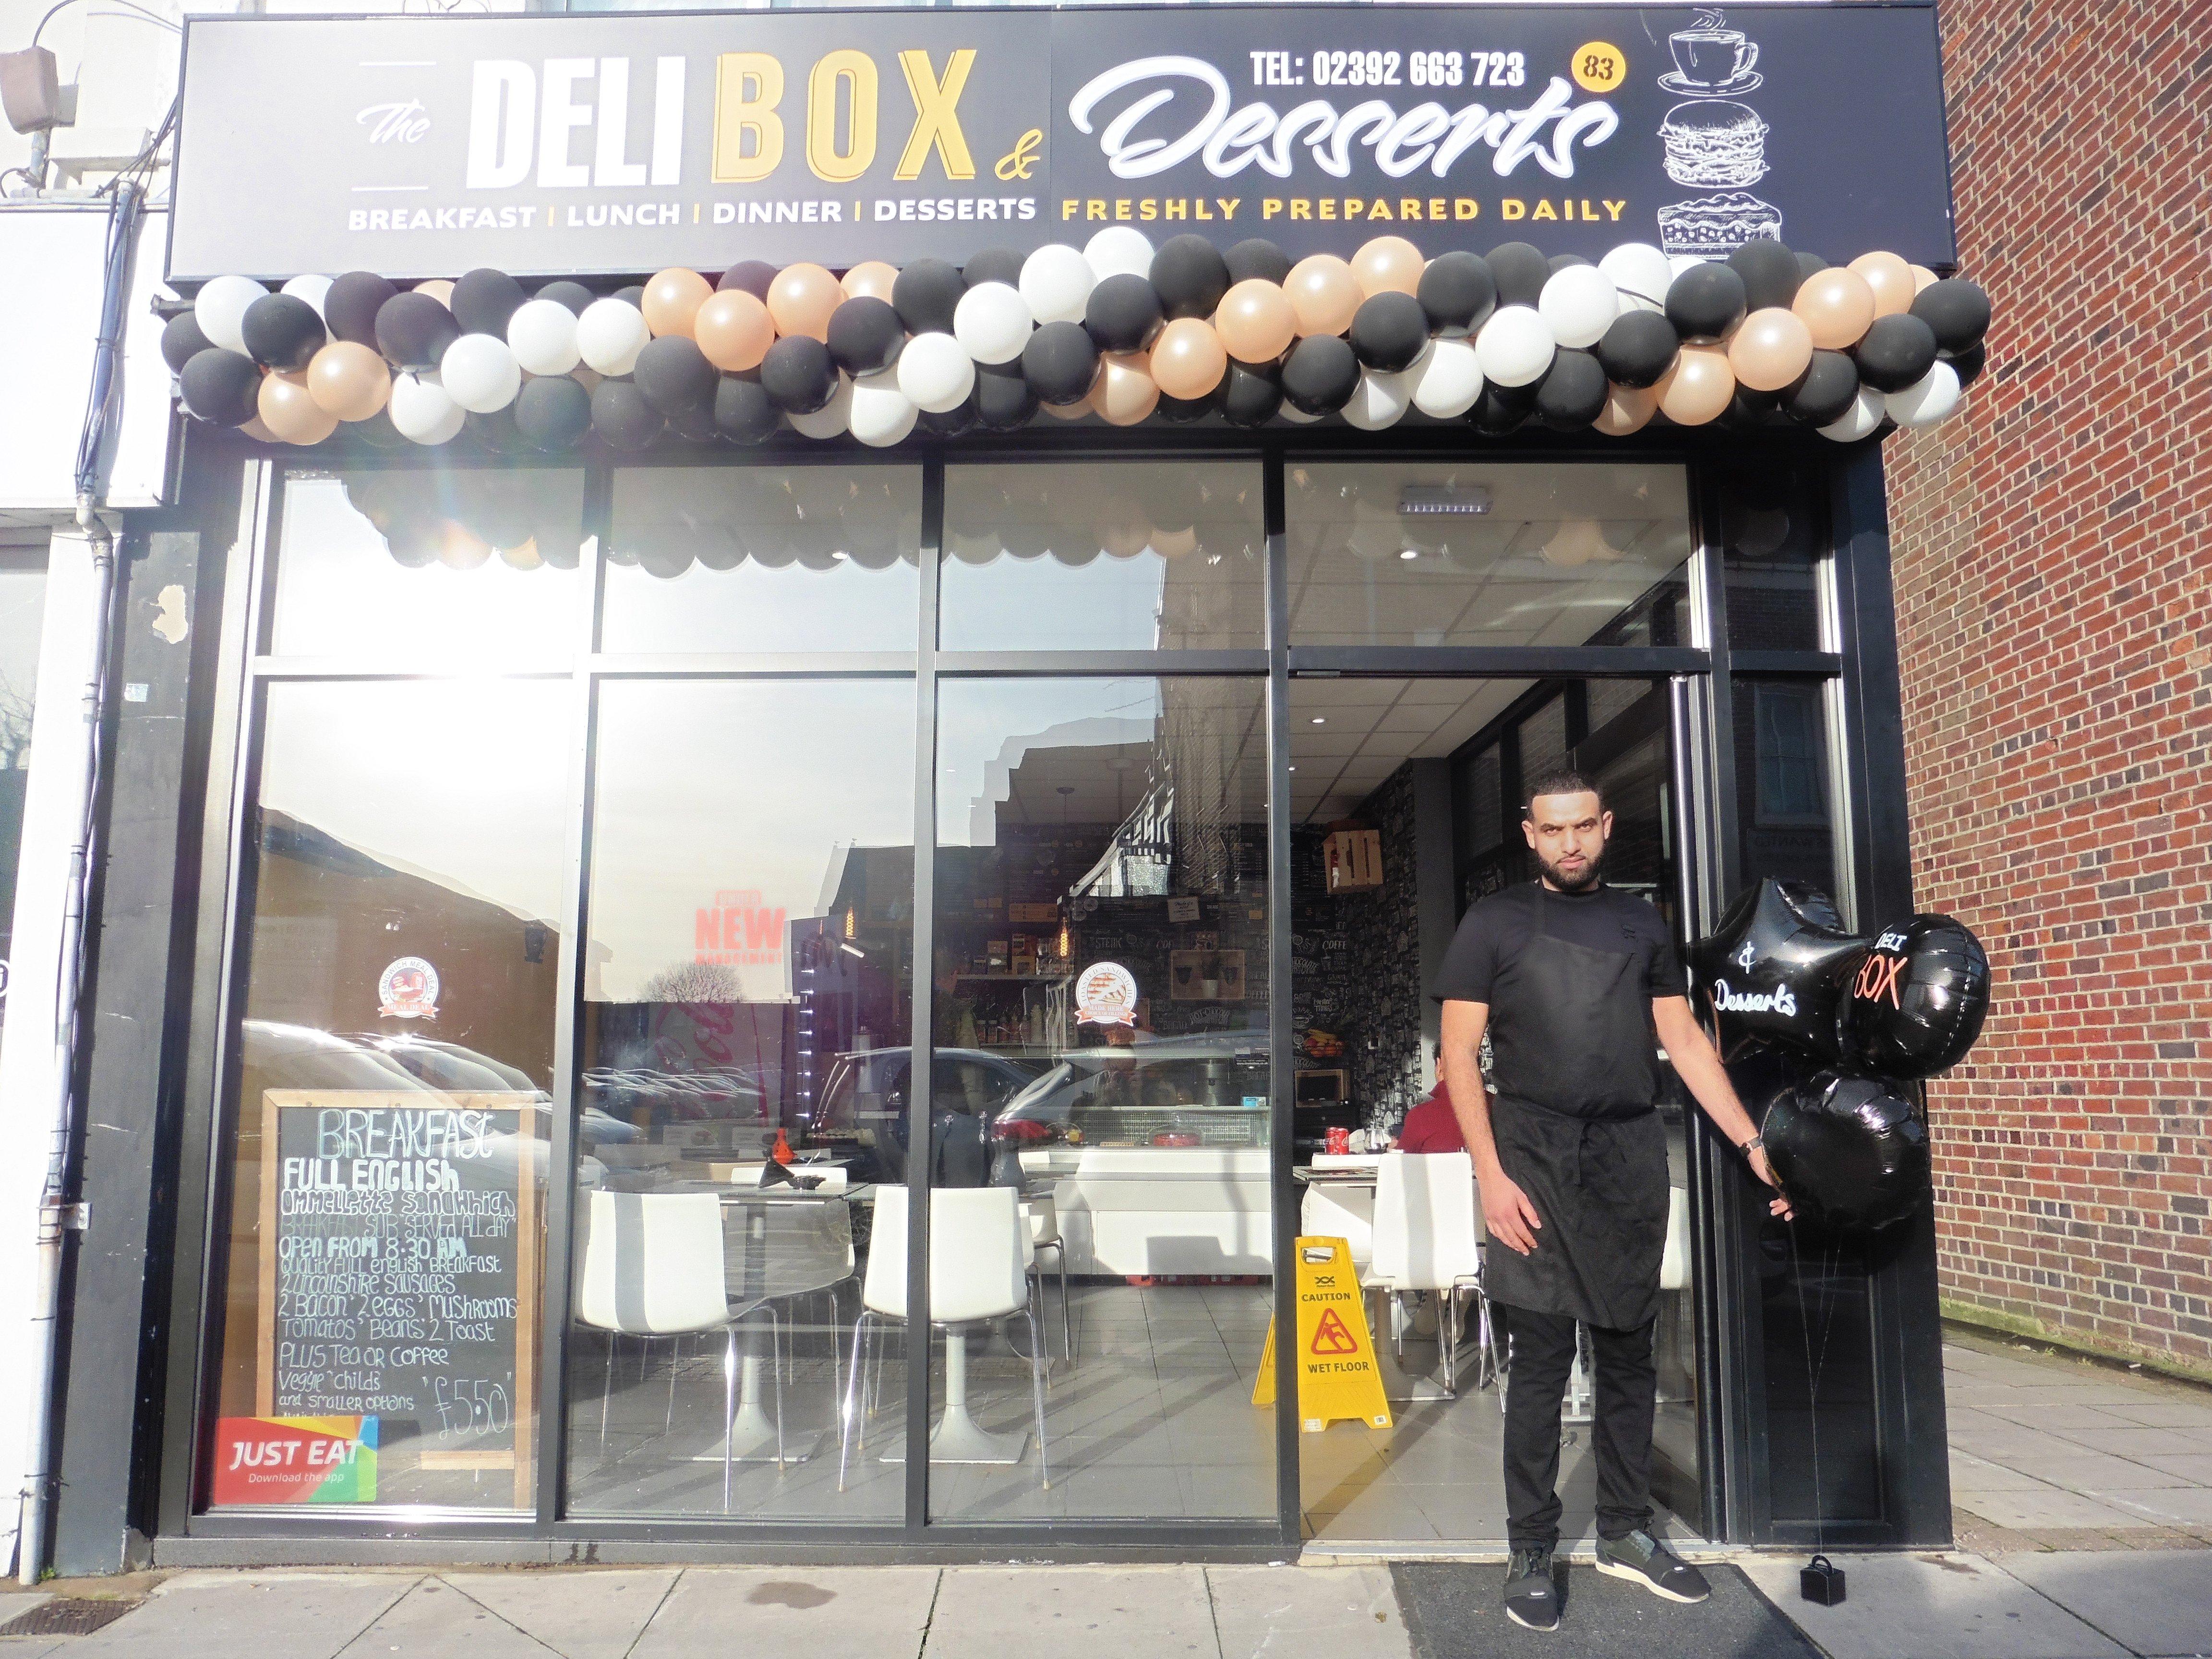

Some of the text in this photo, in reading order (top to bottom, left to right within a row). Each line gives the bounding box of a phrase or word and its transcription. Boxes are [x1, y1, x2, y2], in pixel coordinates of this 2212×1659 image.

[1250, 50, 1525, 86] TEL: 02392 663 723
[1583, 55, 1614, 81] 83
[356, 48, 1618, 189] The DELI BOX & Desserts
[348, 198, 1036, 231] BREAKFAST LUNCH DINNER DESSERTS
[1062, 199, 1626, 221] FRESHLY PREPARED DAILY
[695, 908, 786, 950] NEW
[382, 960, 435, 995] SANDWICH MEAL DEAL
[1081, 966, 1133, 1004] TOASTED SANDWICHES
[1714, 978, 1796, 1017] Desserts
[284, 1157, 346, 1191] FULL
[364, 1214, 398, 1239] SUB
[462, 1214, 484, 1238] ALL
[327, 1236, 378, 1259] FROM
[437, 1237, 468, 1259] AM
[280, 1273, 292, 1294] 2
[278, 1293, 290, 1317] 2
[357, 1294, 371, 1317] 2
[1301, 1292, 1351, 1303] CAUTION
[429, 1319, 444, 1341] 2
[445, 1320, 495, 1342] Toast
[280, 1342, 449, 1369] PLUS Tea OR Coffee
[1308, 1360, 1370, 1374] WET FLOOR
[278, 1394, 302, 1407] and
[366, 1395, 414, 1411] options
[229, 1440, 364, 1472] JUST EAT
[248, 1472, 345, 1486] Download the app
